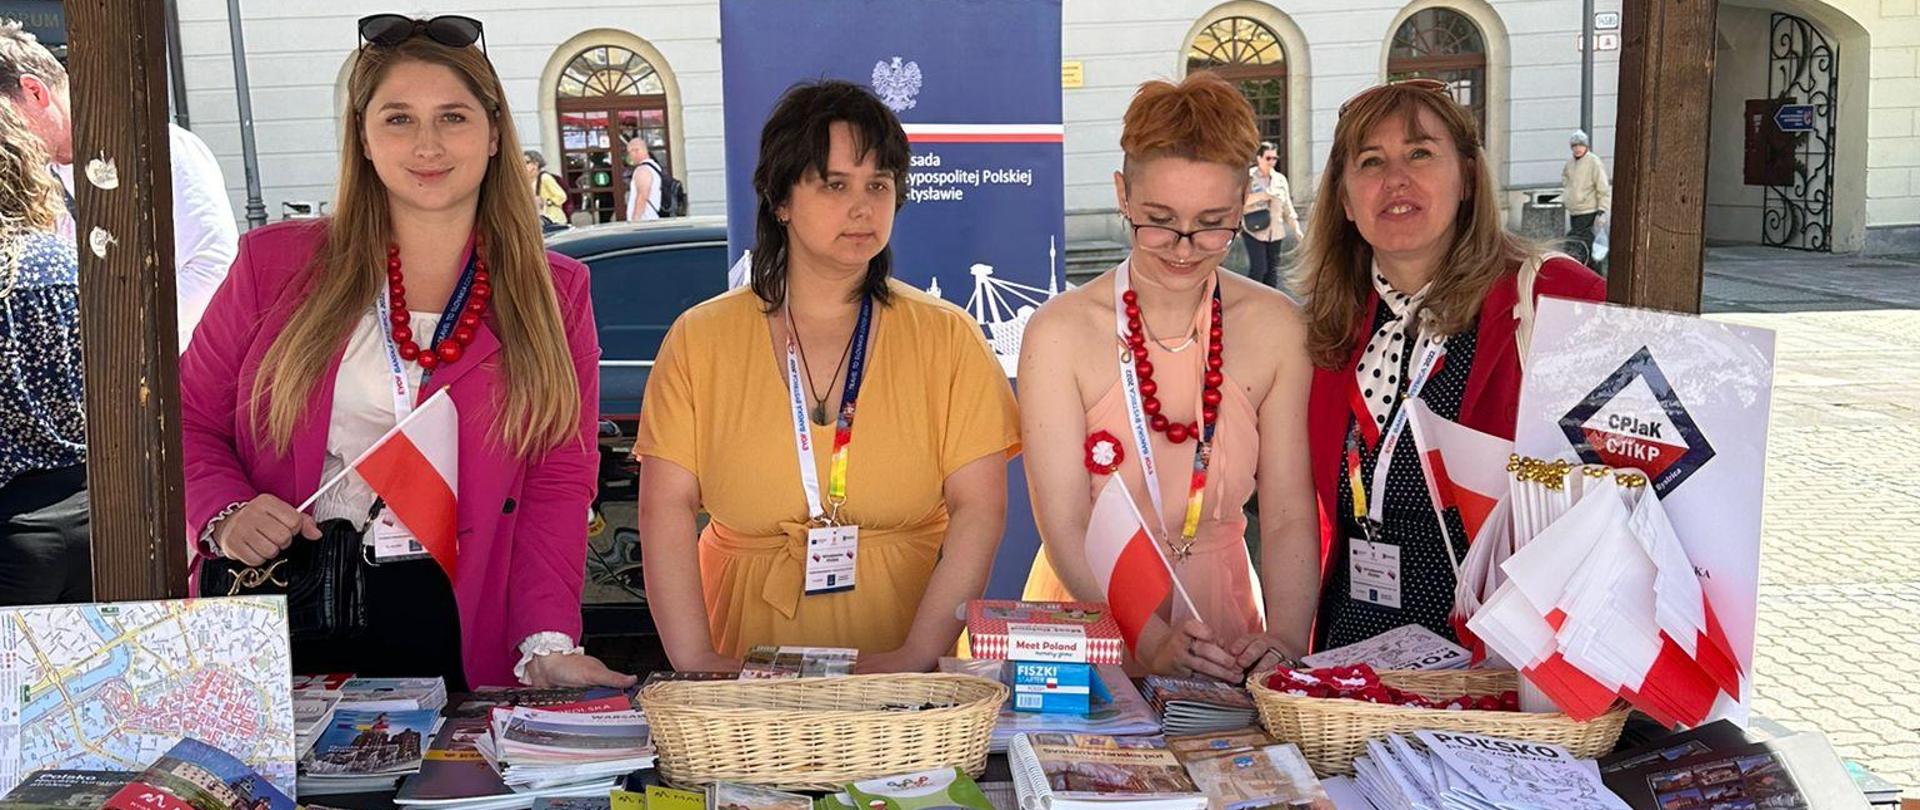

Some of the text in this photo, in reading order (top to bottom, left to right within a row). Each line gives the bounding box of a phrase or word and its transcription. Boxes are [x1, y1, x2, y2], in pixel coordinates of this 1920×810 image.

[910, 152, 941, 166] sada
[982, 169, 1032, 186] Polskiej
[905, 186, 963, 203] tysławie
[1423, 349, 1435, 367] 2022
[1608, 413, 1662, 439] CPJaK
[1693, 564, 1710, 579] KA
[1016, 640, 1077, 651] Meet Poland
[1017, 665, 1057, 677] FISZKI
[1432, 732, 1560, 758] POĽSKO
